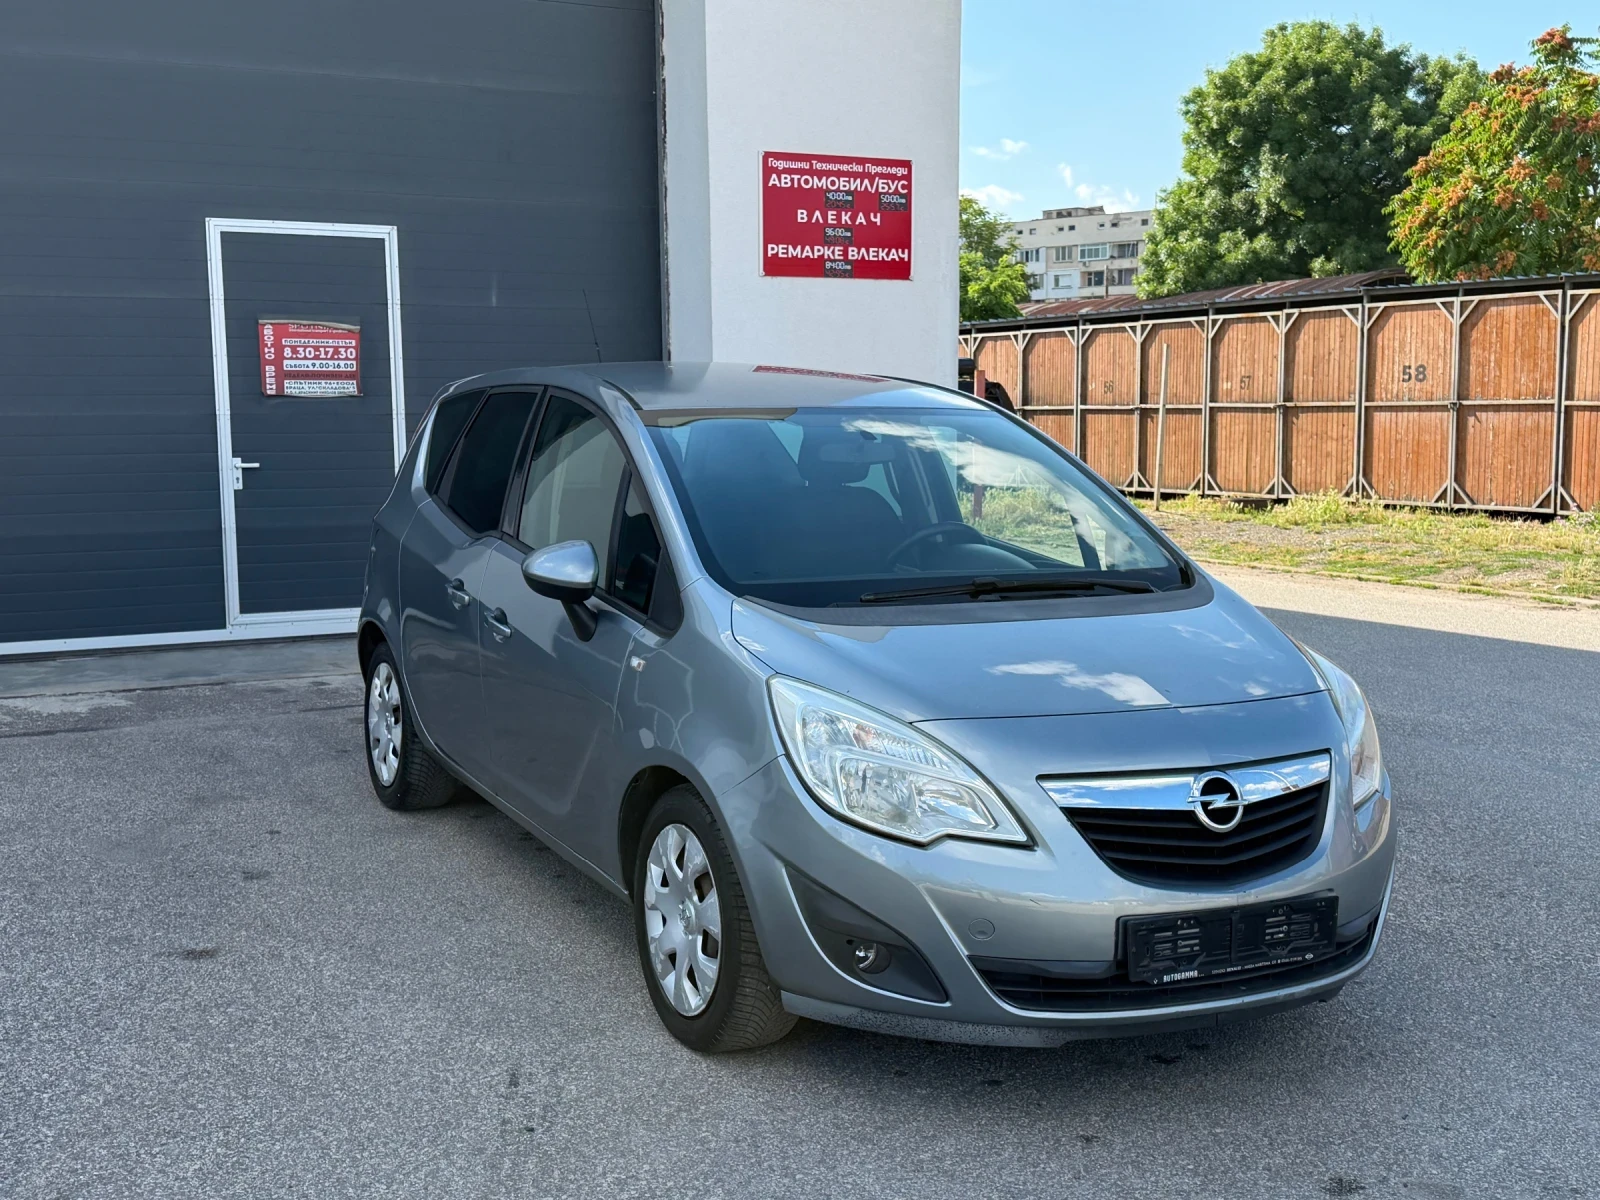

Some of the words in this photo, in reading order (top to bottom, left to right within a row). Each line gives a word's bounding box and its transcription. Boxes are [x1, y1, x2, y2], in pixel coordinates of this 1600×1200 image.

[768, 158, 809, 170] Годишни
[811, 160, 863, 172] Технически
[865, 165, 908, 176] Прегледи
[768, 174, 908, 194] АВТОМОБИЛ/БУС
[767, 244, 844, 260] РЕМАРКЕ
[847, 247, 909, 262] ВЛЕКАЧ
[283, 347, 356, 359] 8.30-17.30
[1402, 364, 1427, 383] 58
[1103, 380, 1114, 394] 56
[1240, 376, 1252, 390] 57
[1163, 970, 1198, 983] AUTOGAMMA
